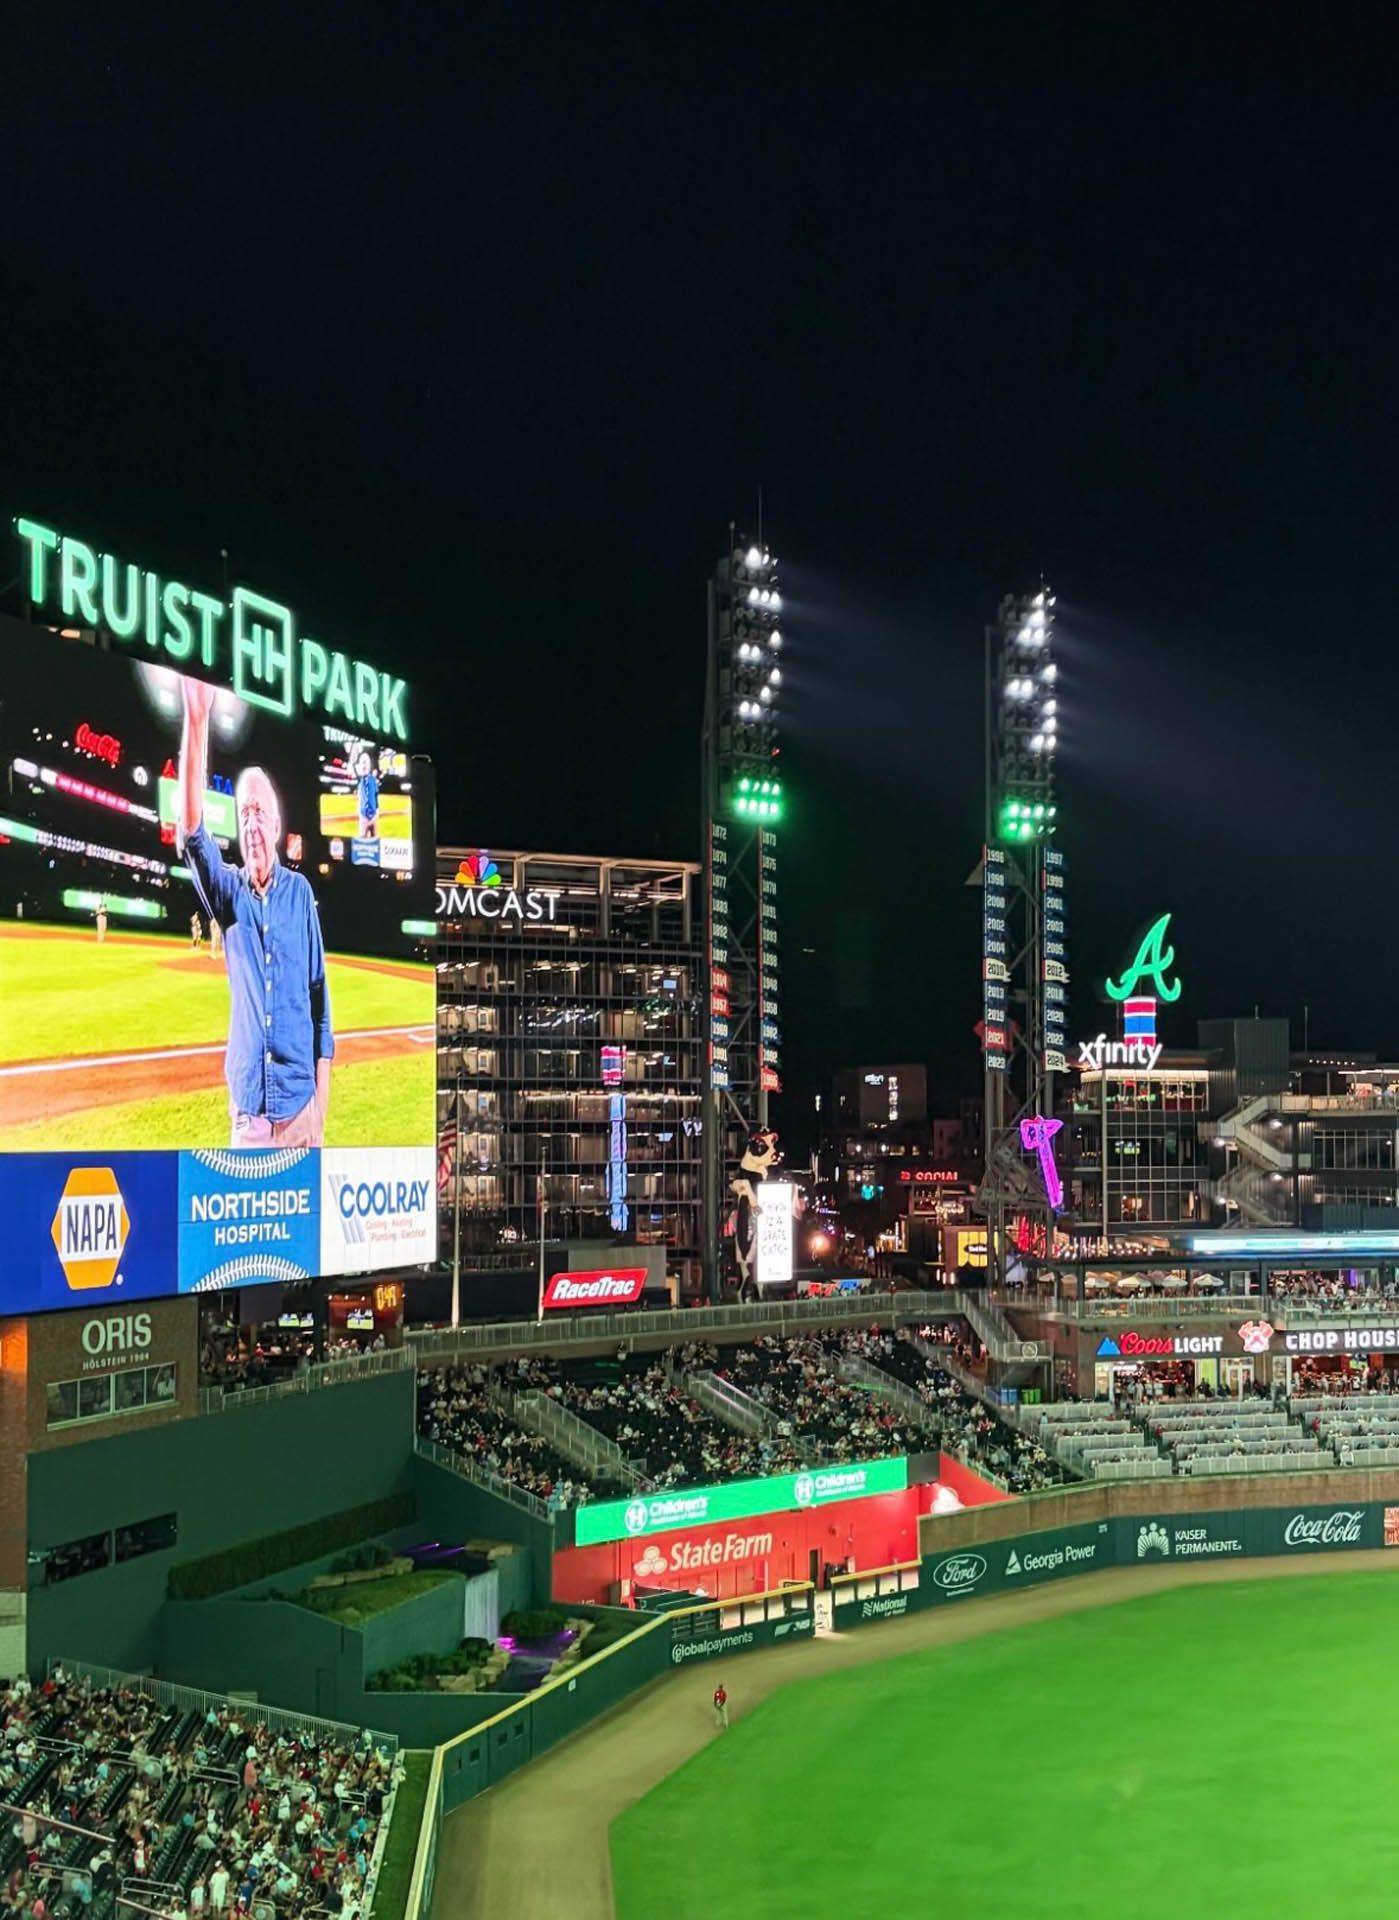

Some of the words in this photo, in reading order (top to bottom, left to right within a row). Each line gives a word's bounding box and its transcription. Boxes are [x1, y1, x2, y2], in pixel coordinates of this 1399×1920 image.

[17, 517, 224, 667] TRUIST
[301, 638, 408, 739] PARK
[1078, 1032, 1163, 1071] xfinity
[191, 1188, 311, 1222] NORTHSIDE
[340, 1179, 430, 1218] COOLRAY
[66, 1203, 118, 1254] NAPA
[214, 1221, 291, 1247] HOSPITAL
[551, 1276, 636, 1300] RaceTrac
[81, 1313, 152, 1355] ORIS
[1120, 1332, 1173, 1356] Coors
[1174, 1336, 1223, 1354] LIGHT
[1286, 1332, 1338, 1350] CHOP
[1344, 1330, 1399, 1349] HOUS
[1175, 1529, 1207, 1542] KAISER
[1284, 1510, 1366, 1546] Coca-Cola
[1023, 1549, 1064, 1570] Georgia
[1065, 1544, 1096, 1562] Power
[1175, 1540, 1239, 1555] PERMANENTE
[943, 1559, 977, 1585] Ford
[872, 1594, 907, 1614] National
